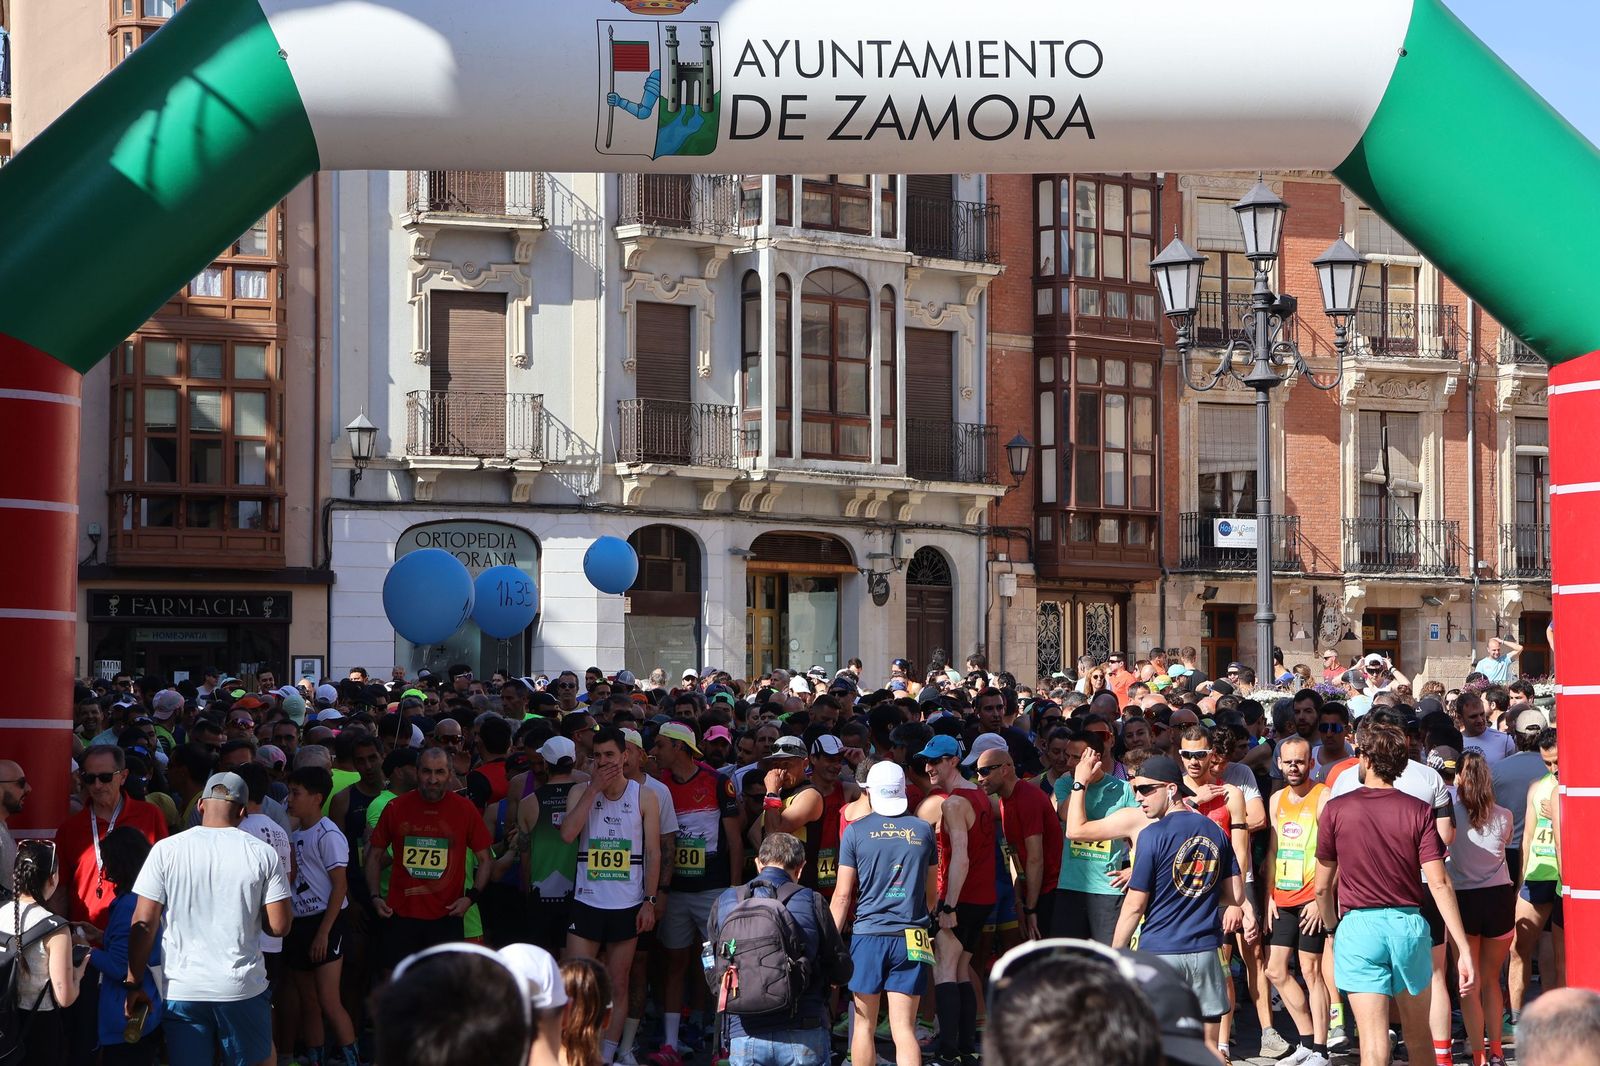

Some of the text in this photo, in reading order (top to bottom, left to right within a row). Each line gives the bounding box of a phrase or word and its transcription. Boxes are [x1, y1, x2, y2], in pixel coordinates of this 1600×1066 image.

[733, 39, 1104, 79] AYUNTAMIENTO
[729, 93, 1096, 141] DE ZAMORA
[1219, 523, 1239, 533] Hostal
[415, 531, 517, 549] ORTOPEDIA
[450, 551, 517, 568] ORANA
[497, 579, 533, 608] 1h35
[131, 597, 251, 616] FARMACIA
[406, 848, 441, 866] 275
[591, 850, 623, 868] 169
[674, 848, 700, 866] 80
[1282, 861, 1288, 876] 1
